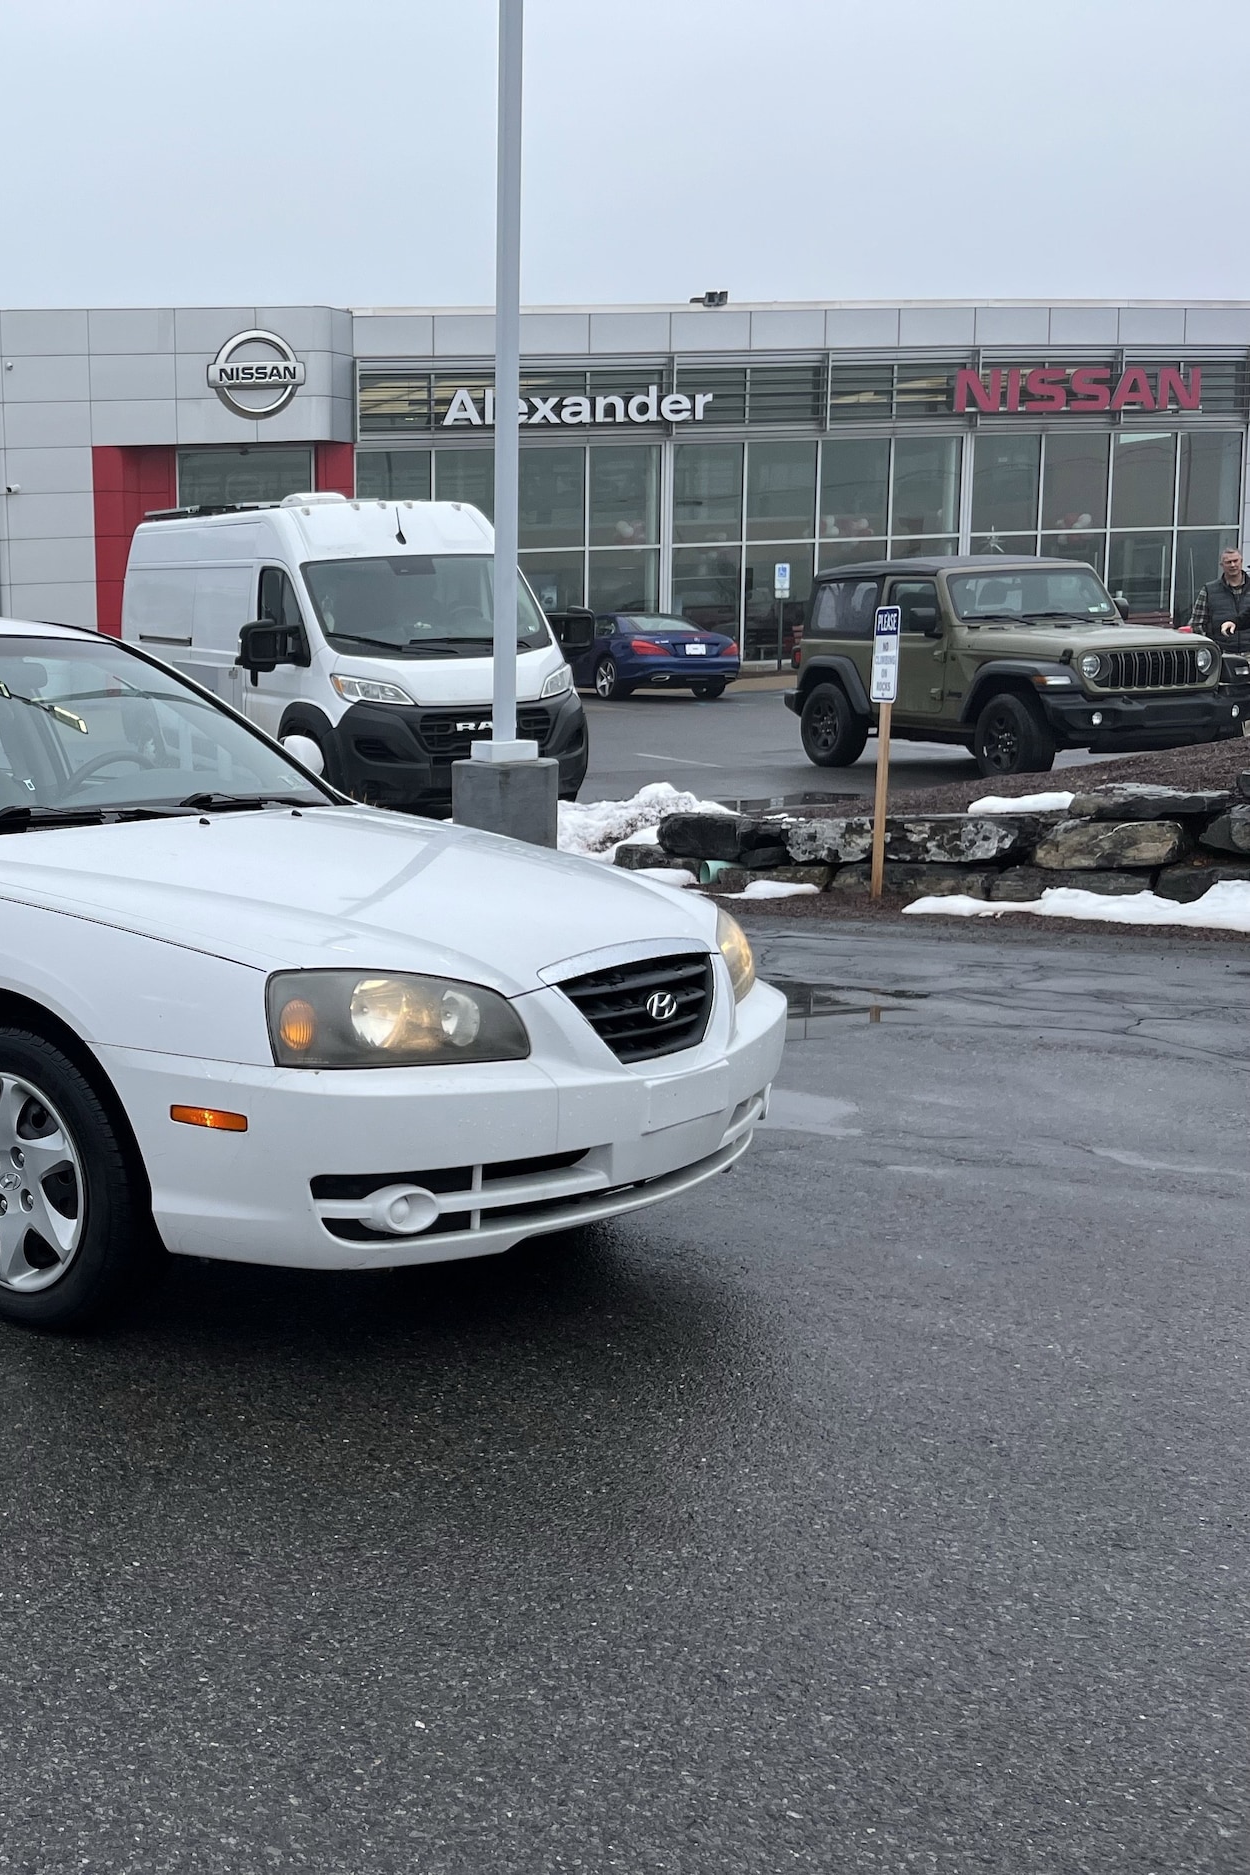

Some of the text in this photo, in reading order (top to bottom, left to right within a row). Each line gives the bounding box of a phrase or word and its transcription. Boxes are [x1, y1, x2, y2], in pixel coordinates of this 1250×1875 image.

[218, 366, 296, 382] NISSAN
[954, 367, 1202, 412] NISSAN
[877, 613, 898, 631] PLEASE
[456, 721, 493, 731] RA
